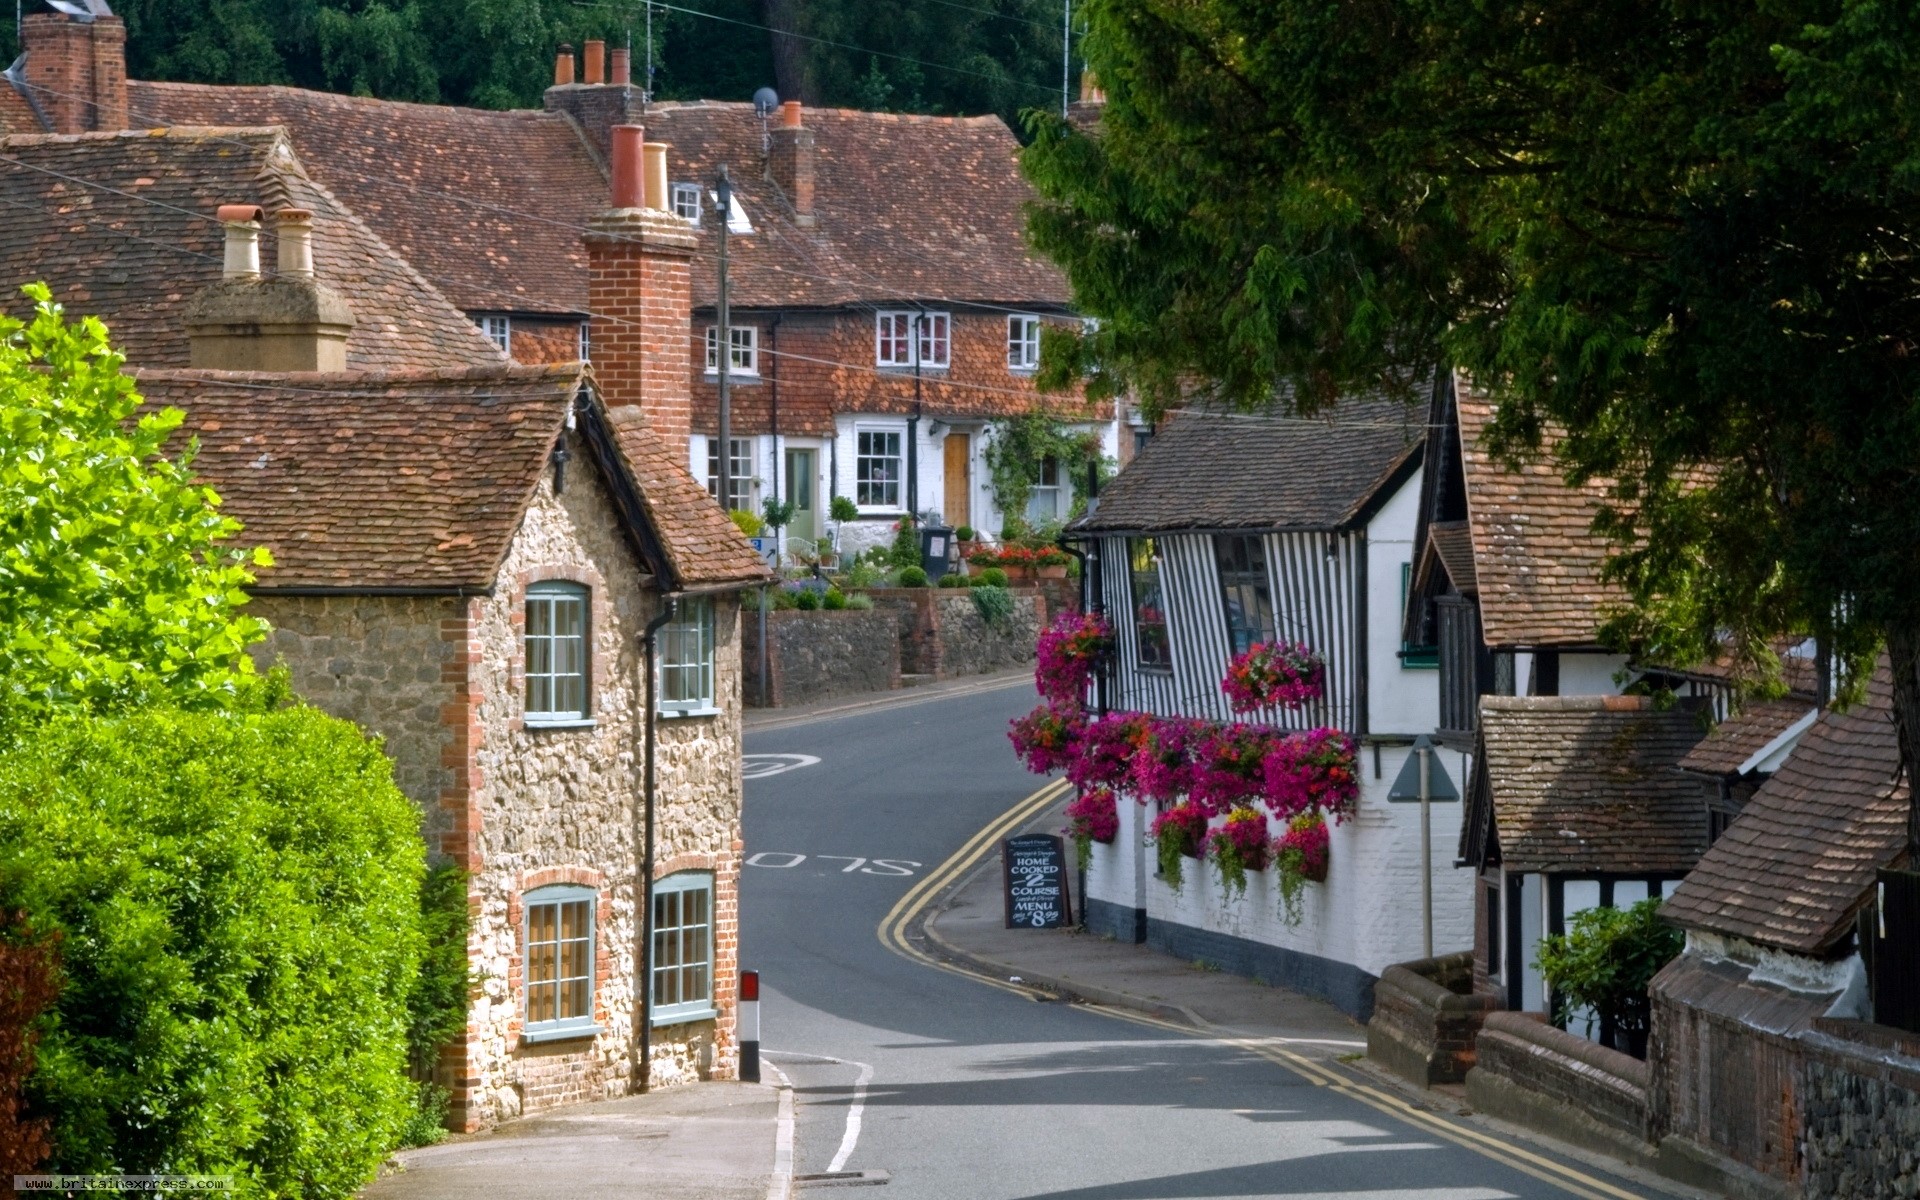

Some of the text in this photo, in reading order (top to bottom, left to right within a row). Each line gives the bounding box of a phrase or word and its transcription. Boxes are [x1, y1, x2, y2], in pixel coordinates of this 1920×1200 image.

[1017, 858, 1050, 866] HOME
[1011, 866, 1059, 874] COOKED
[1025, 873, 1044, 887] 2
[1011, 887, 1060, 896] COURSE
[1014, 902, 1053, 910] MENU
